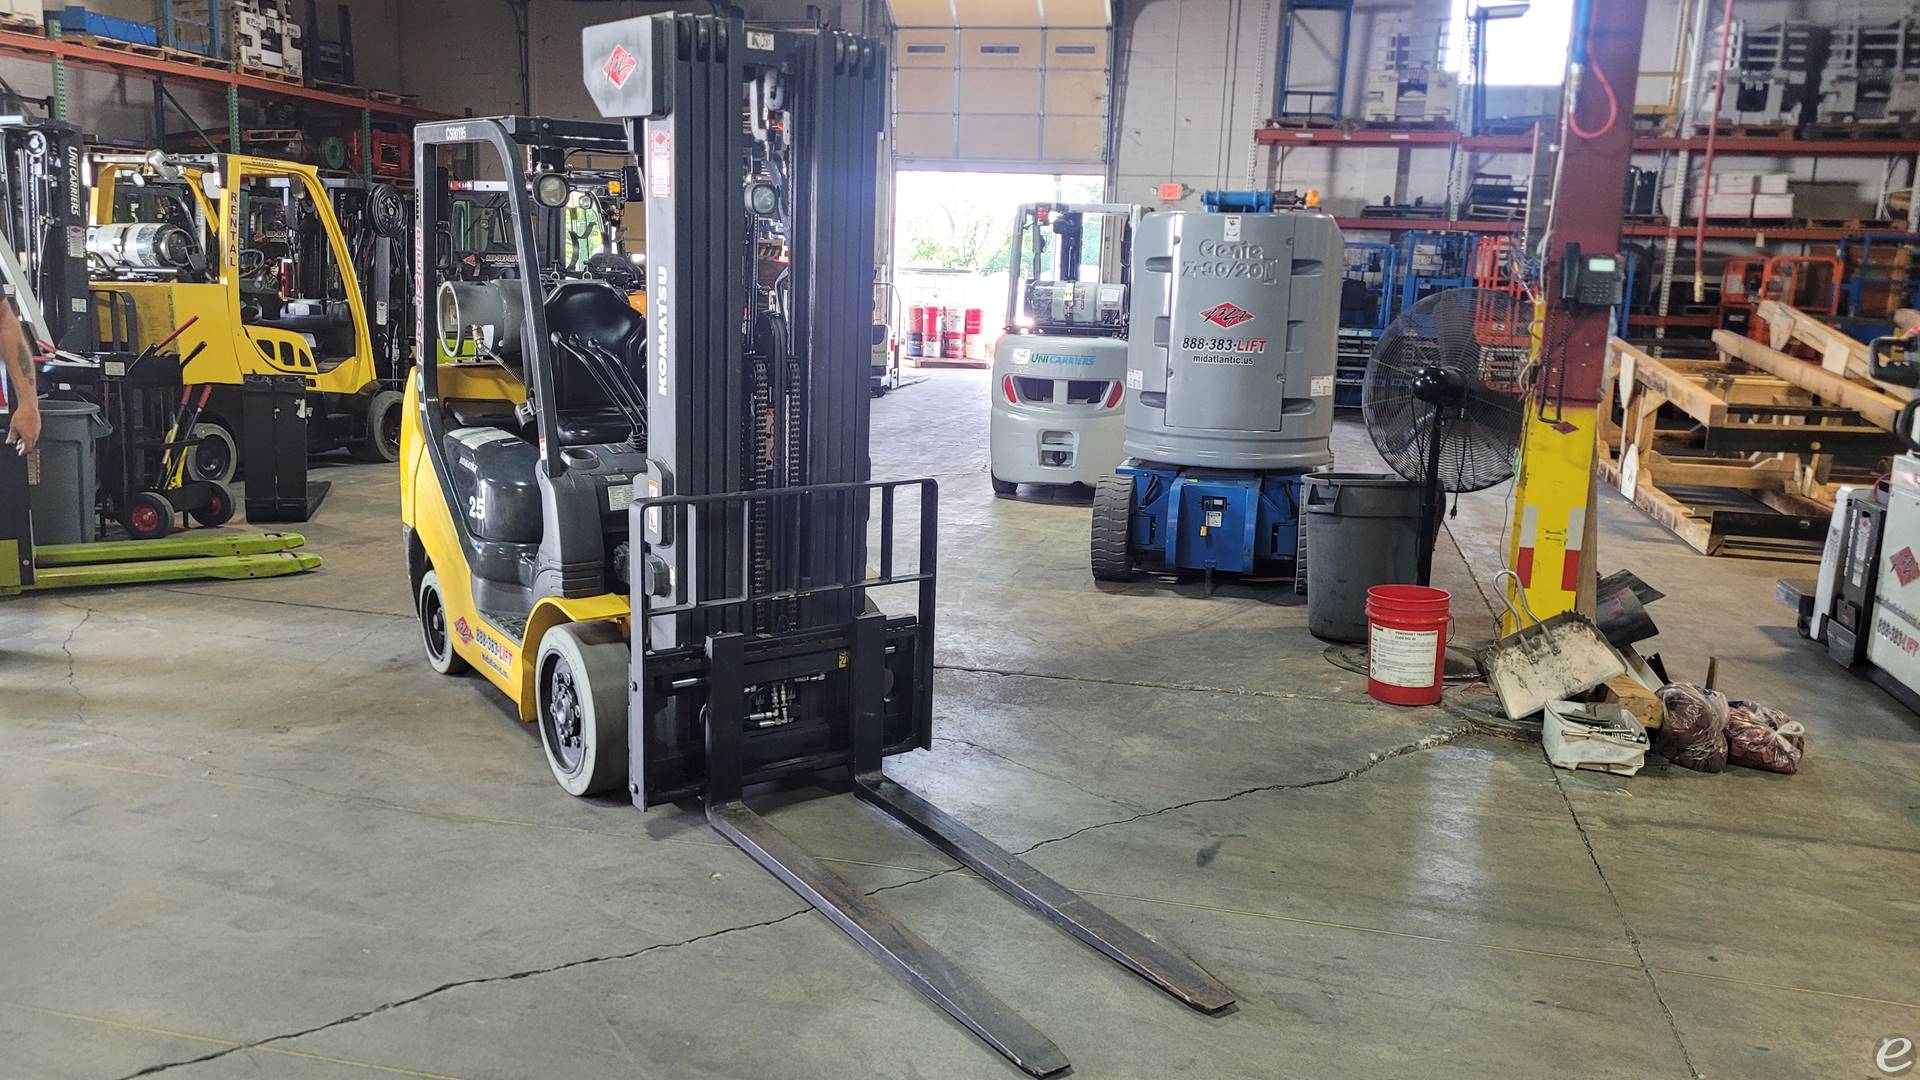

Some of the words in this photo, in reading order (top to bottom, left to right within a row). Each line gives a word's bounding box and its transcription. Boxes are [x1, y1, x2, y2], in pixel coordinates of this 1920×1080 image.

[68, 146, 81, 217] UNICARRIERS
[230, 192, 238, 267] RENTAL
[1199, 239, 1264, 260] Genie
[656, 265, 668, 397] KOMATSU
[1193, 354, 1254, 365] midatlantic.us
[469, 495, 486, 519] 25
